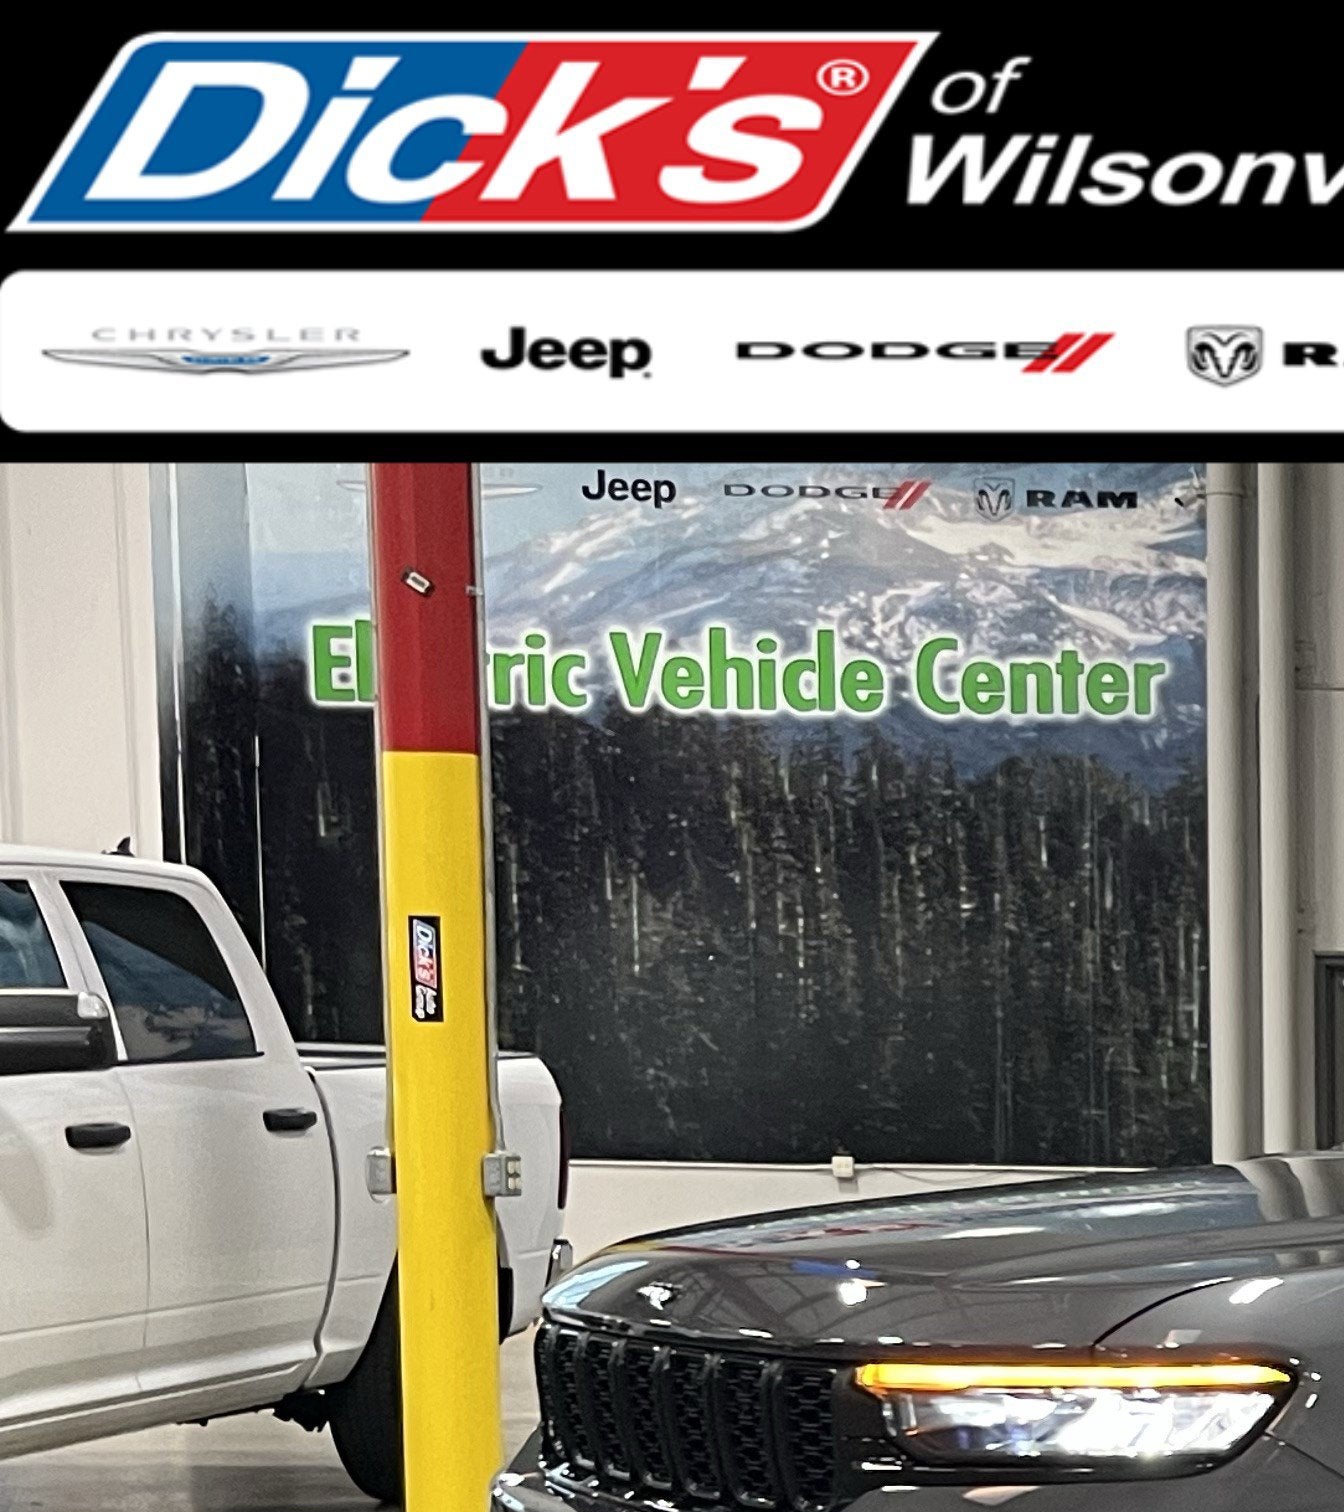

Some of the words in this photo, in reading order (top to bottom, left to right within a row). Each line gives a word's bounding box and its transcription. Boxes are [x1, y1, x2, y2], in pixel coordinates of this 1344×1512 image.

[581, 469, 677, 509] Jeep
[722, 482, 897, 500] DODGE
[1025, 488, 1139, 510] RAM
[311, 618, 589, 707] Elric
[609, 626, 885, 713] Vehicle
[915, 637, 1166, 716] Center
